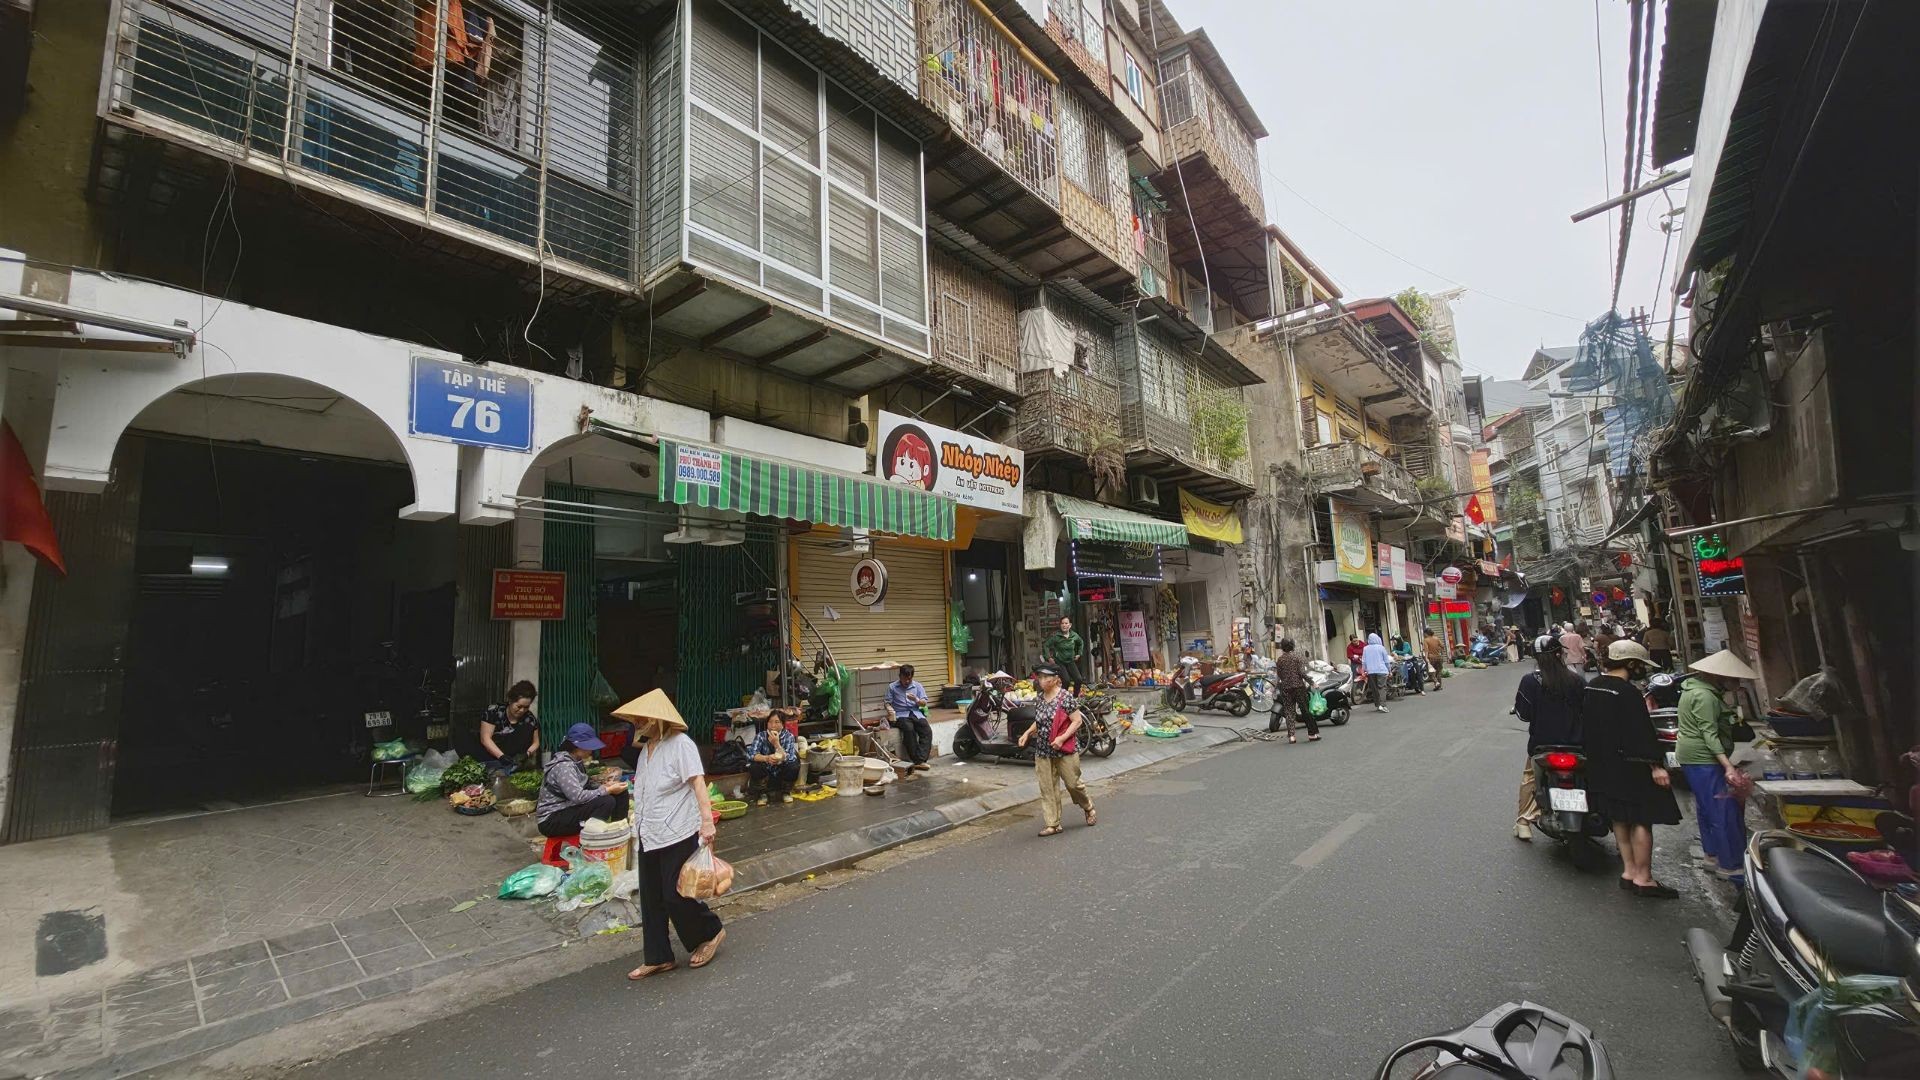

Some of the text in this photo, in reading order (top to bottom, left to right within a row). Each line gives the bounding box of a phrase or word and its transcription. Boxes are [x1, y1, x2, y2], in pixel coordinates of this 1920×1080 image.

[442, 368, 506, 395] TẬP THỂ
[447, 394, 501, 434] 76
